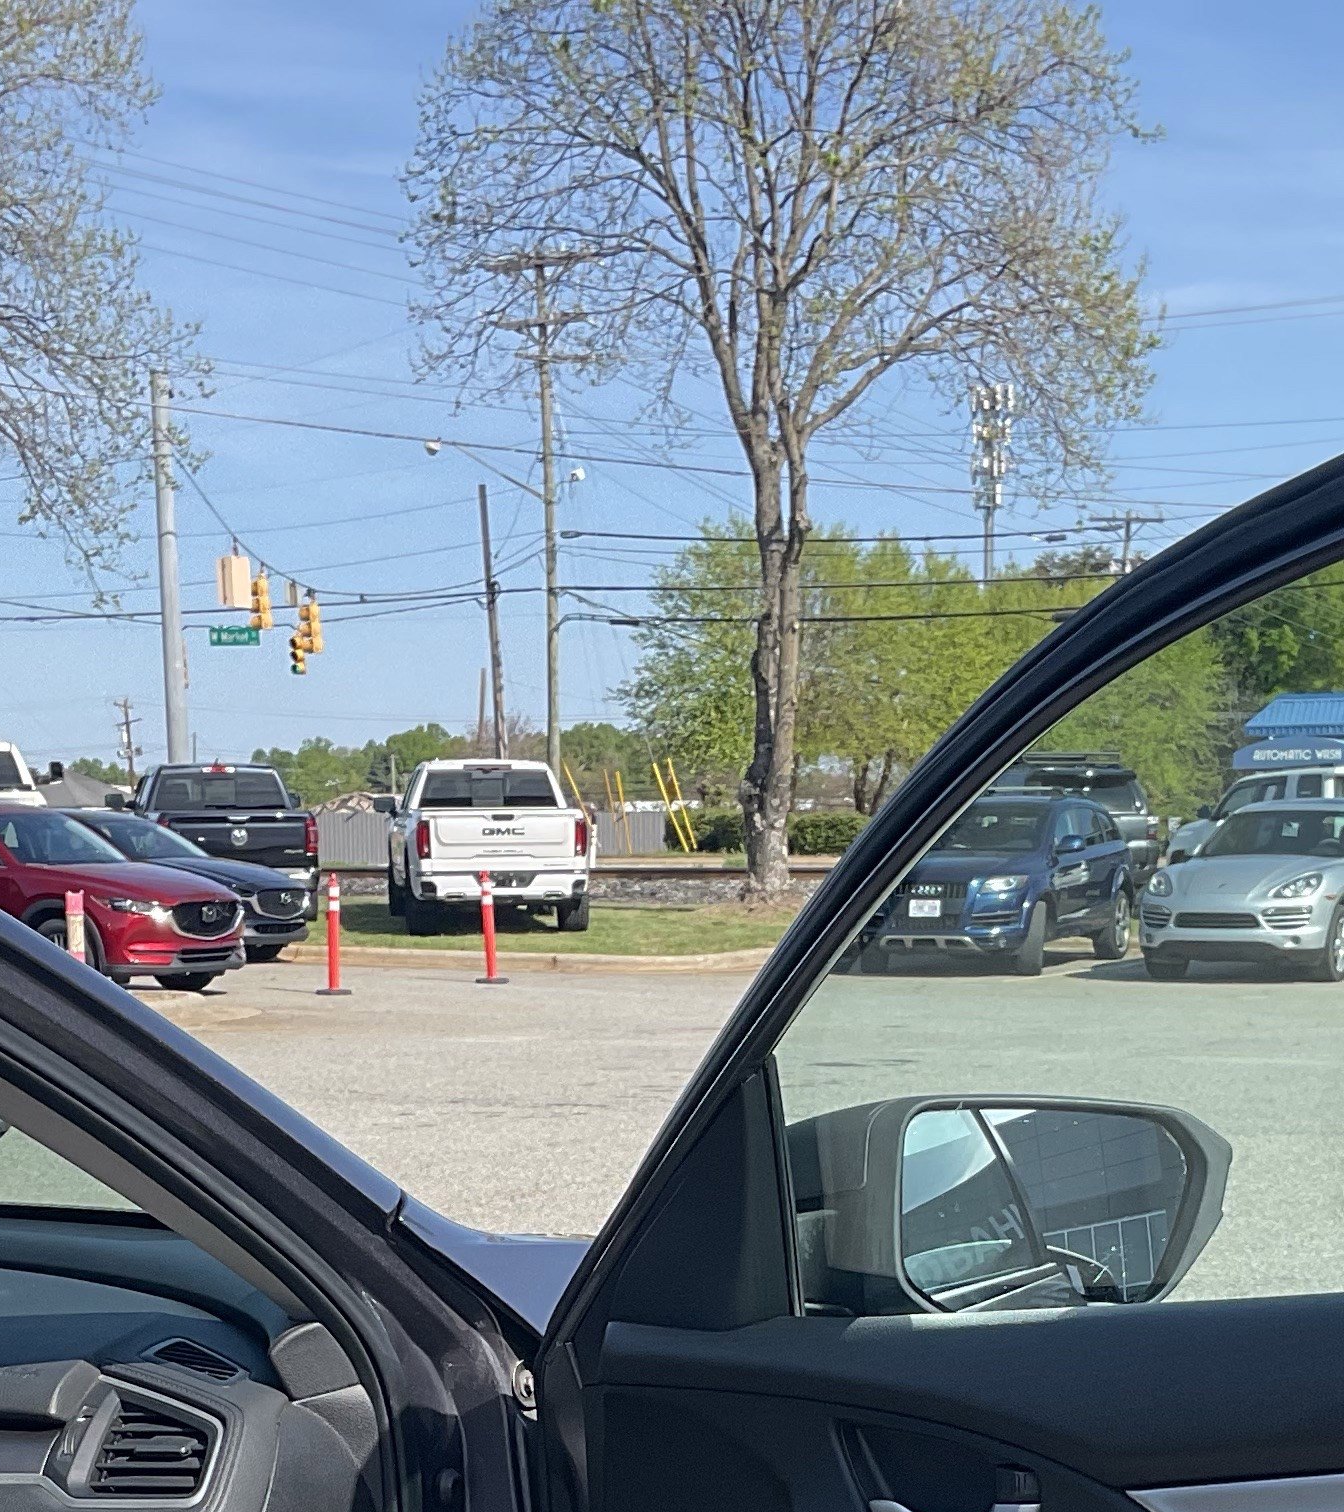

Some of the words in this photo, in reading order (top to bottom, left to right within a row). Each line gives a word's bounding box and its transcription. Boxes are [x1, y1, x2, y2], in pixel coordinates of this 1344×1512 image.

[1253, 748, 1312, 761] AUTOMATIC
[1315, 748, 1343, 761] WASH
[481, 827, 525, 836] GMC
